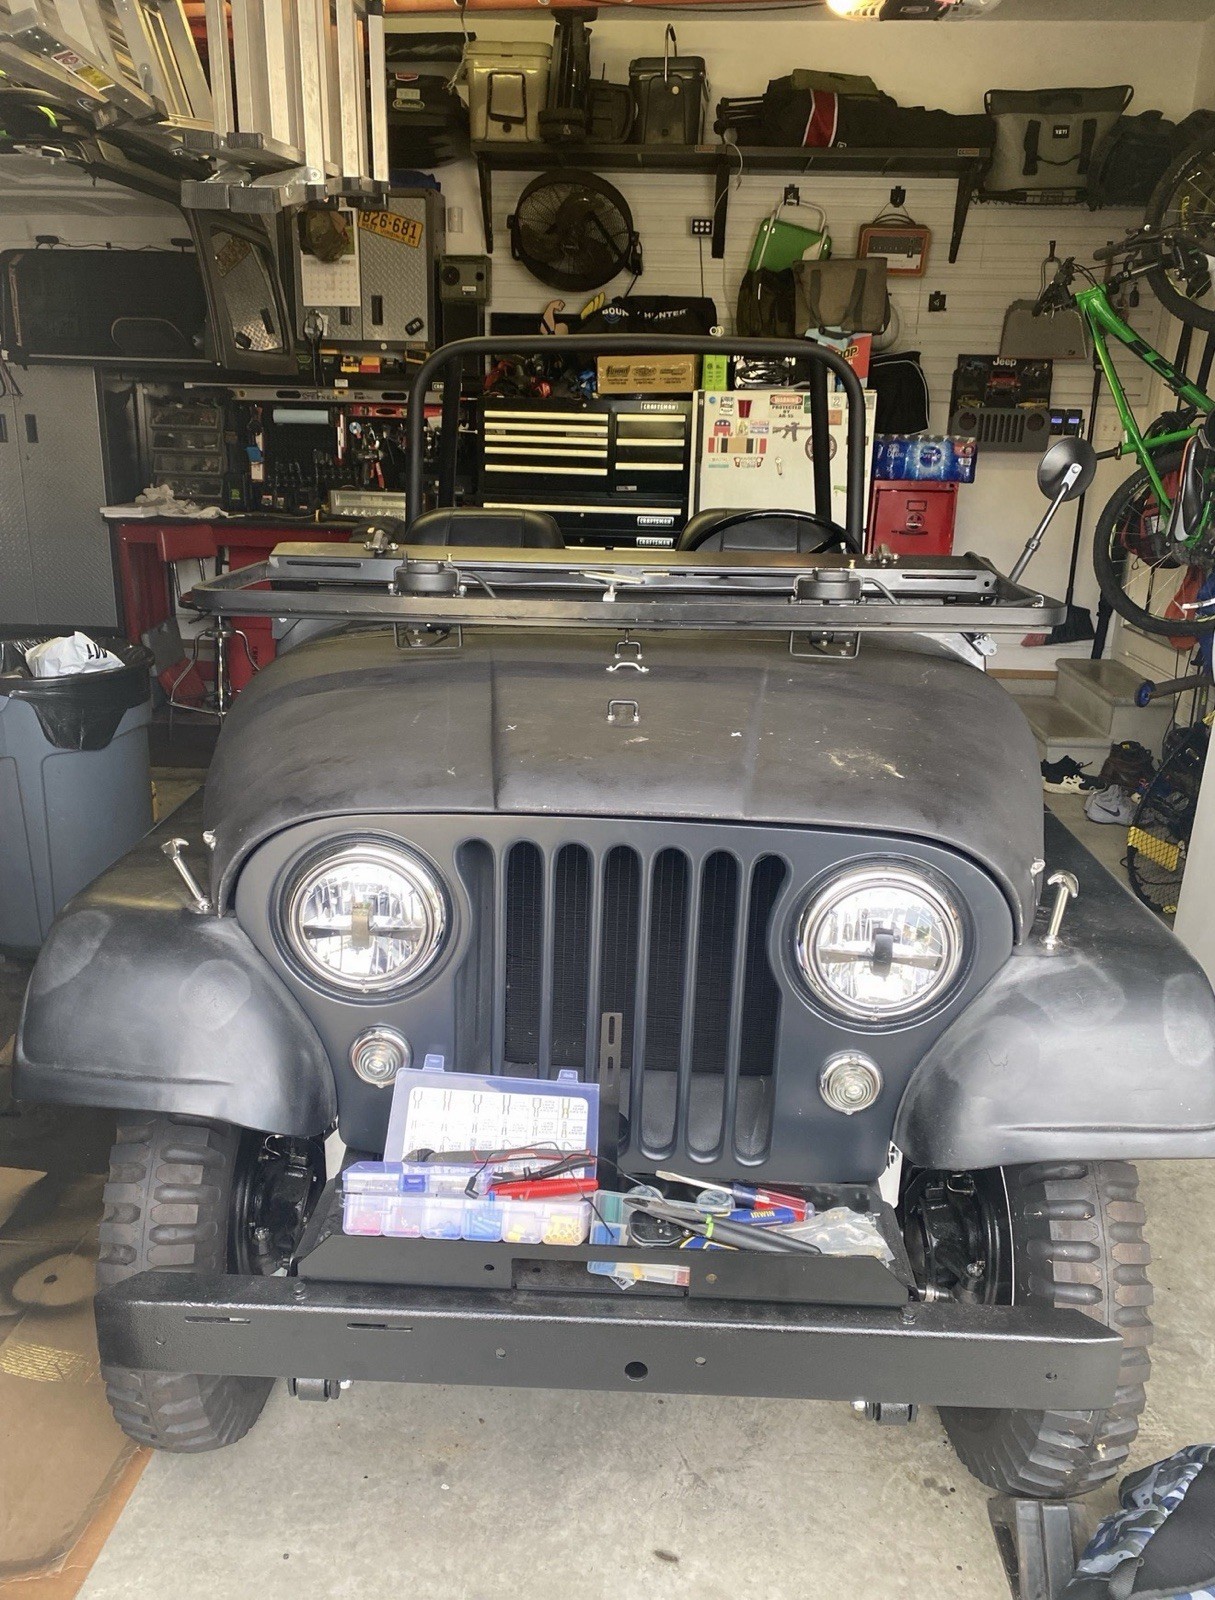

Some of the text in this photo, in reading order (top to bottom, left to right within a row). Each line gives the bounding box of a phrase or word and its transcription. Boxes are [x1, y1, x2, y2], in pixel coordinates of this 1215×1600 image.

[992, 356, 1017, 368] Jeep
[639, 517, 672, 525] CRAFTSMAN
[638, 538, 671, 546] CRAFTSMAN
[750, 1210, 775, 1219] IRWIN
